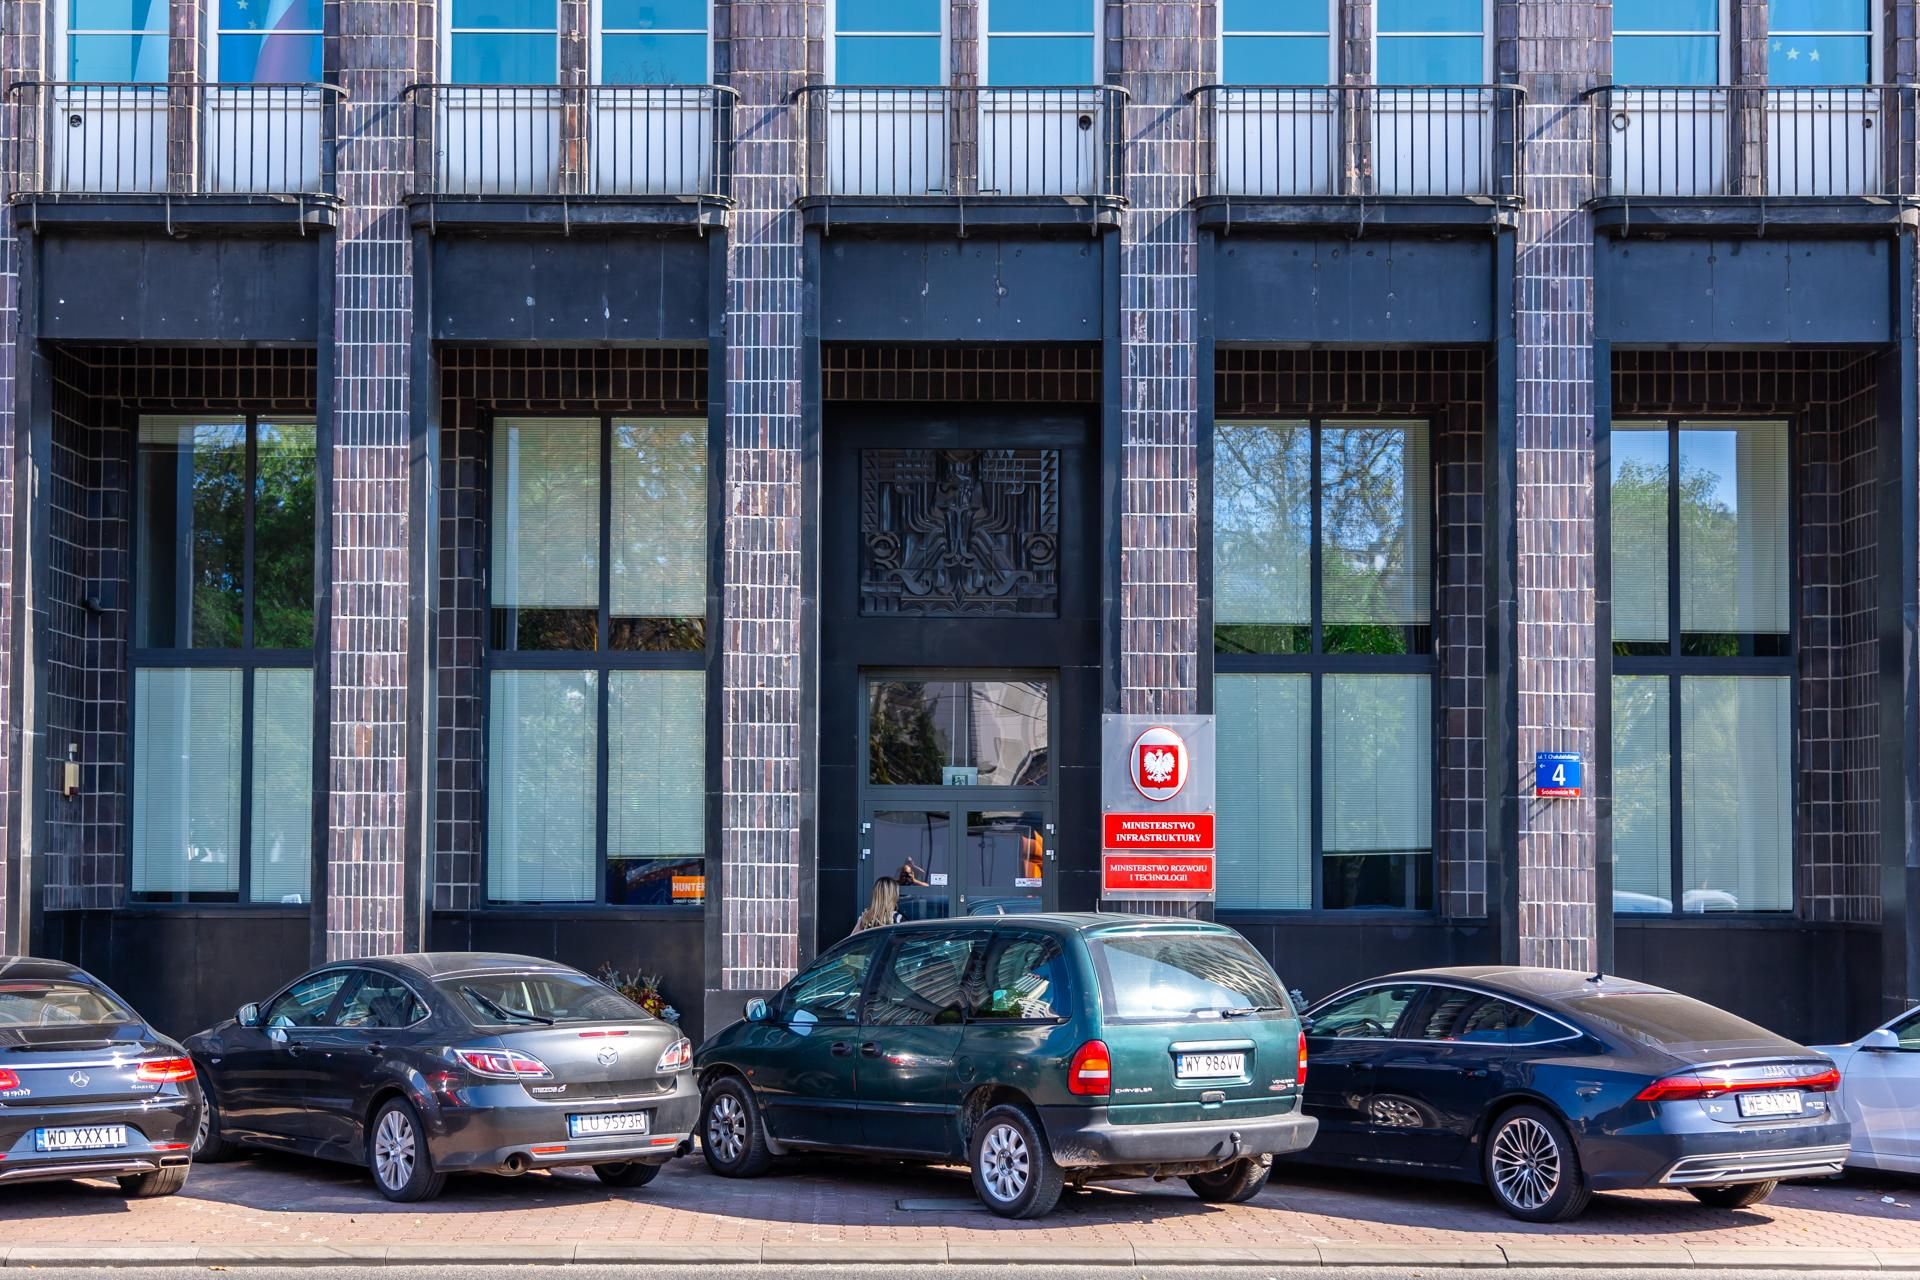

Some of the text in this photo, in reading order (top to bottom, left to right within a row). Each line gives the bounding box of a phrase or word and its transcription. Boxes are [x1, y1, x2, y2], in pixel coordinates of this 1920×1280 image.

[1552, 763, 1566, 786] 4
[1122, 821, 1195, 830] MINISTERSTWO
[1116, 833, 1202, 842] INFRASTRUKTURY
[1110, 864, 1170, 872] MINISTERSTWO
[1185, 1055, 1241, 1072] WY 986VV
[580, 1113, 643, 1131] LU 9593R
[73, 1127, 120, 1144] XXX11
